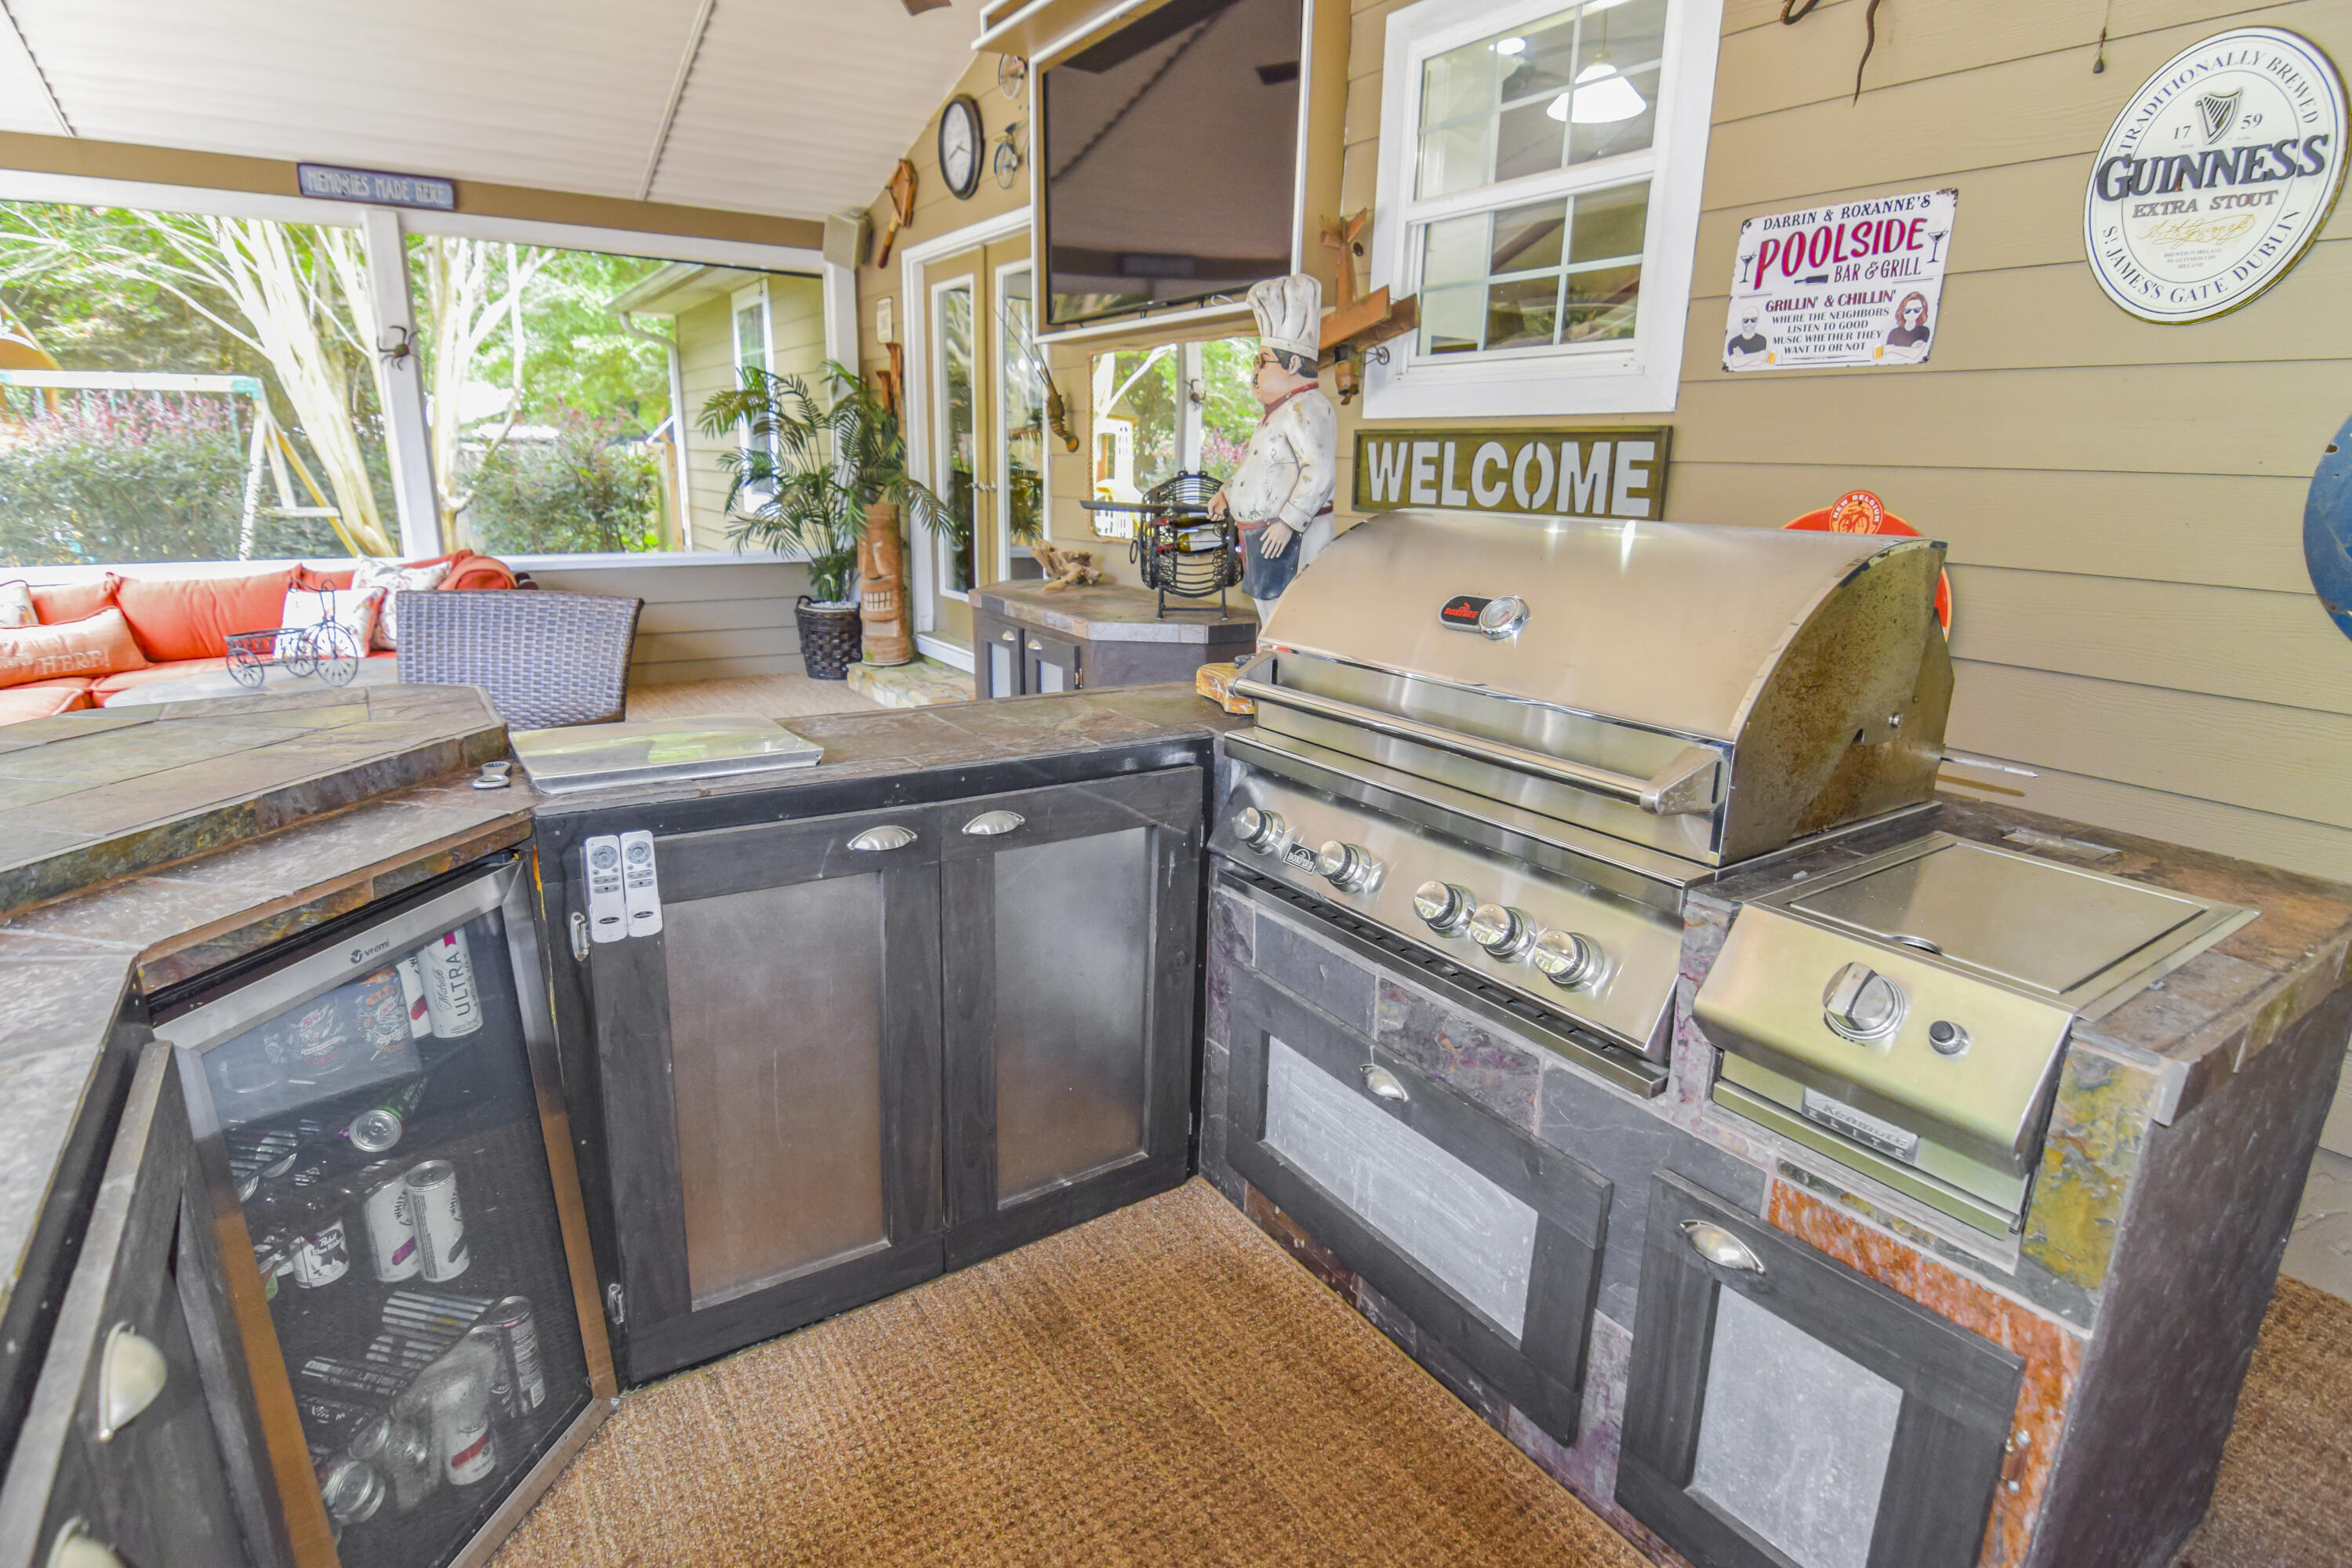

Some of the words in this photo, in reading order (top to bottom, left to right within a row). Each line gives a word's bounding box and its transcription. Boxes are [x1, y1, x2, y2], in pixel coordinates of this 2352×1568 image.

[2118, 50, 2266, 151] TRADITIONALLY
[2266, 56, 2319, 124] BREWED
[2173, 125, 2191, 140] 17
[2241, 114, 2263, 129] 59
[2096, 134, 2328, 201] GUINNESS
[307, 170, 369, 196] MEMORIES
[375, 176, 410, 201] MADE
[414, 181, 446, 204] HERE
[1763, 211, 1817, 230] DARRIN
[1824, 209, 1834, 222] &
[1842, 194, 1932, 220] ROXANNE'S
[2132, 198, 2198, 218] EXTRA
[2209, 190, 2278, 210] STOUT
[1754, 217, 1928, 291] POOLSIDE
[2170, 278, 2228, 303] GATE
[2234, 209, 2301, 281] DUBLIN
[1834, 263, 1860, 283] BAR
[1865, 261, 1878, 279] &
[1881, 256, 1922, 278] GRILL
[1766, 296, 1819, 313] GRILLIN'
[1824, 295, 1835, 307] &
[1838, 289, 1896, 307] CHILLIN'
[1772, 313, 1806, 325] WHERE
[1808, 311, 1828, 322] THE
[1830, 307, 1889, 320] NEIGHBORS
[1788, 322, 1820, 333] LISTEN
[1822, 321, 1835, 332] TO
[1838, 320, 1868, 330] GOOD
[1773, 333, 1802, 345] MUSIC
[1805, 332, 1852, 343] WHETHER
[1855, 330, 1883, 341] THEY
[1784, 343, 1810, 354] WANT
[1813, 343, 1825, 353] TO
[1828, 343, 1842, 352] OR
[1845, 341, 1866, 351] NOT
[1367, 441, 1656, 517] WELCOME
[1833, 499, 1849, 519] NEW
[1852, 494, 1880, 523] BELGIUM
[365, 938, 390, 956] vremi
[445, 951, 471, 1016] ULTRA
[1809, 1109, 1904, 1158] ELITE
